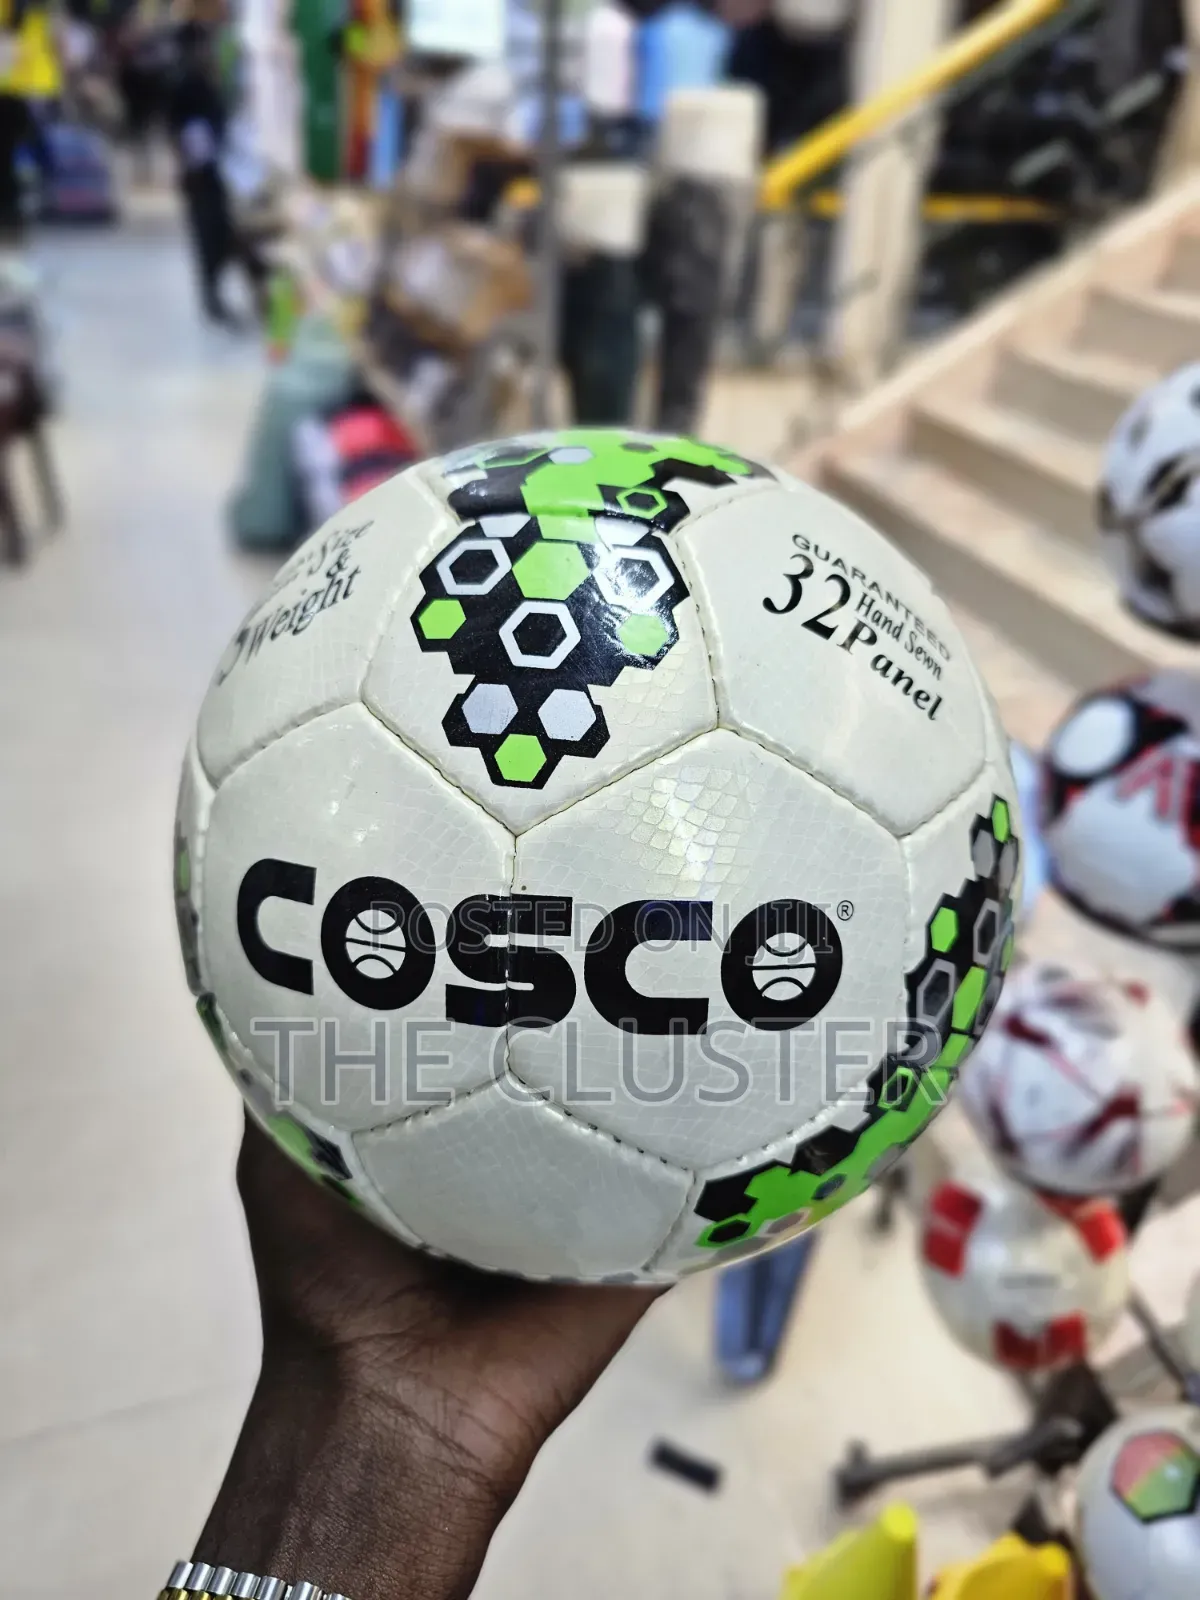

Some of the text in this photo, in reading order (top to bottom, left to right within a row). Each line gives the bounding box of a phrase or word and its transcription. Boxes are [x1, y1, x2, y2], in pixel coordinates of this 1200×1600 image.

[245, 565, 362, 665] Weight
[762, 553, 943, 721] 32 Panel
[791, 534, 951, 662] GUARANTEED
[854, 591, 942, 681] Hand Sewn
[237, 858, 843, 1035] COSCO
